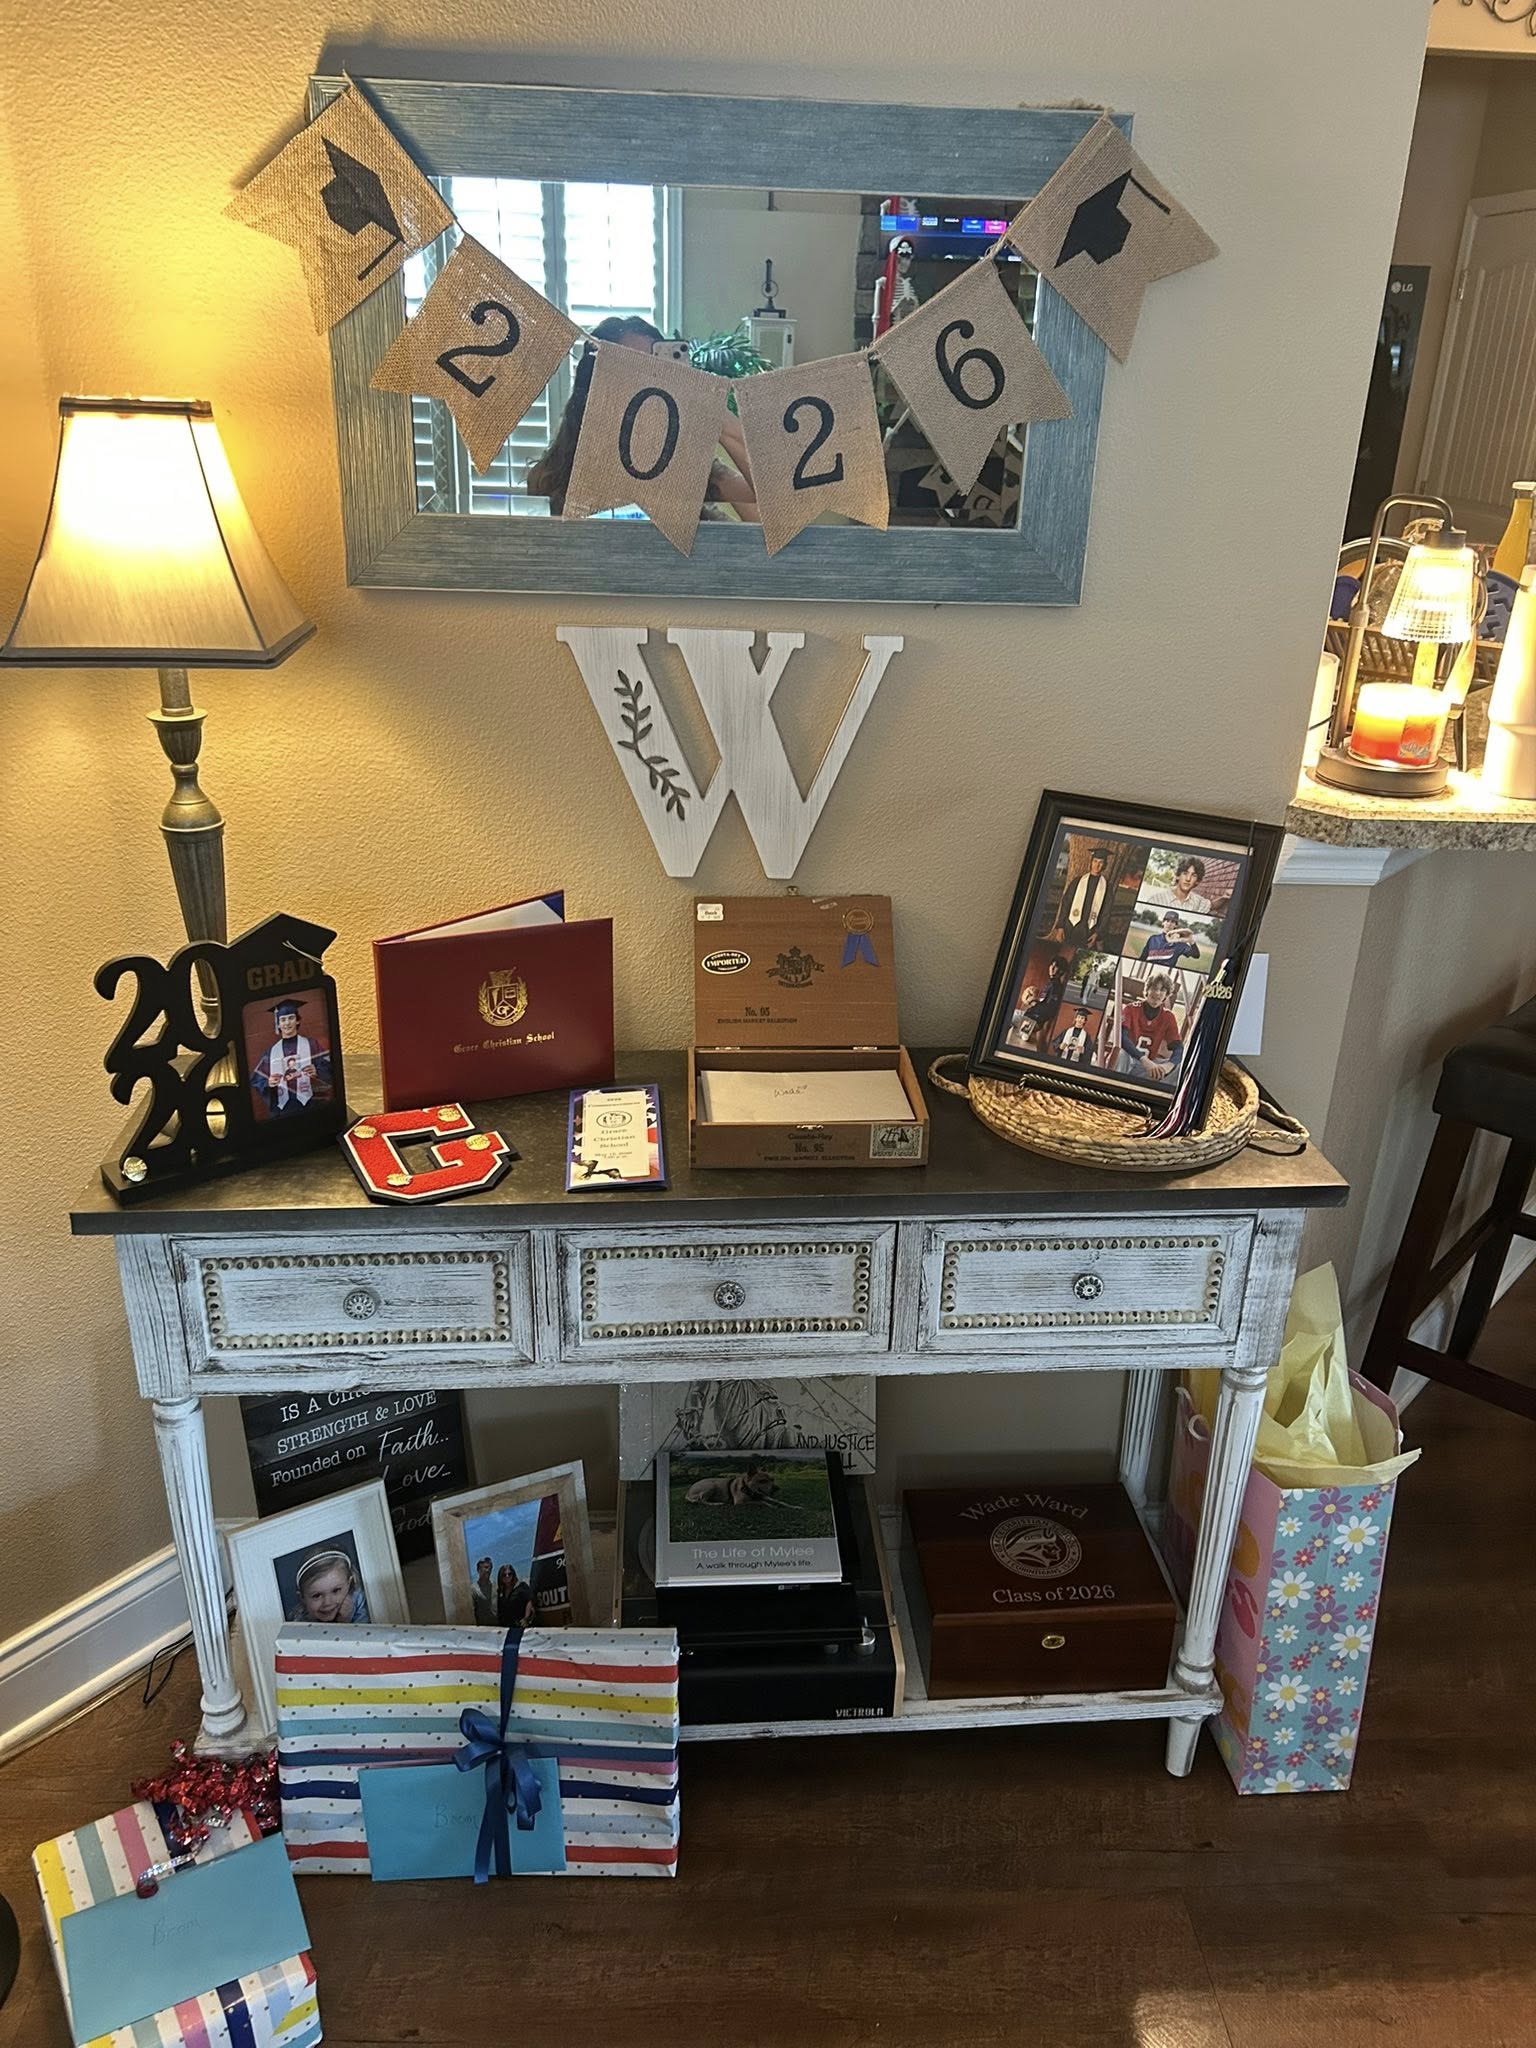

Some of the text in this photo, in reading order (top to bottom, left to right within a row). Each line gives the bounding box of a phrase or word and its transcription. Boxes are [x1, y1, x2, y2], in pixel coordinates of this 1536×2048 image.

[1402, 283, 1414, 292] LG
[556, 626, 905, 880] W
[706, 957, 747, 968] IMPORTED
[246, 957, 317, 990] GRAD
[1204, 985, 1232, 999] 2026
[482, 1038, 522, 1050] Christian
[525, 1031, 555, 1045] School
[343, 1101, 512, 1198] G
[813, 1142, 825, 1152] 95
[280, 1403, 300, 1423] IS
[306, 1397, 322, 1414] A
[277, 1410, 369, 1455] STRENGTH
[375, 1406, 389, 1421] &
[394, 1390, 437, 1416] LOVE
[822, 1432, 875, 1450] JUSTICE
[270, 1451, 341, 1488] Founded
[346, 1445, 367, 1460] on
[841, 1452, 857, 1469] LL
[959, 1493, 1089, 1520] Wade Ward
[694, 1546, 815, 1559] The Life of Mylee
[728, 1561, 763, 1569] through
[764, 1560, 797, 1569] Mylee's
[992, 1584, 1115, 1603] Class of 2026
[836, 1707, 884, 1717] VICTROLA
